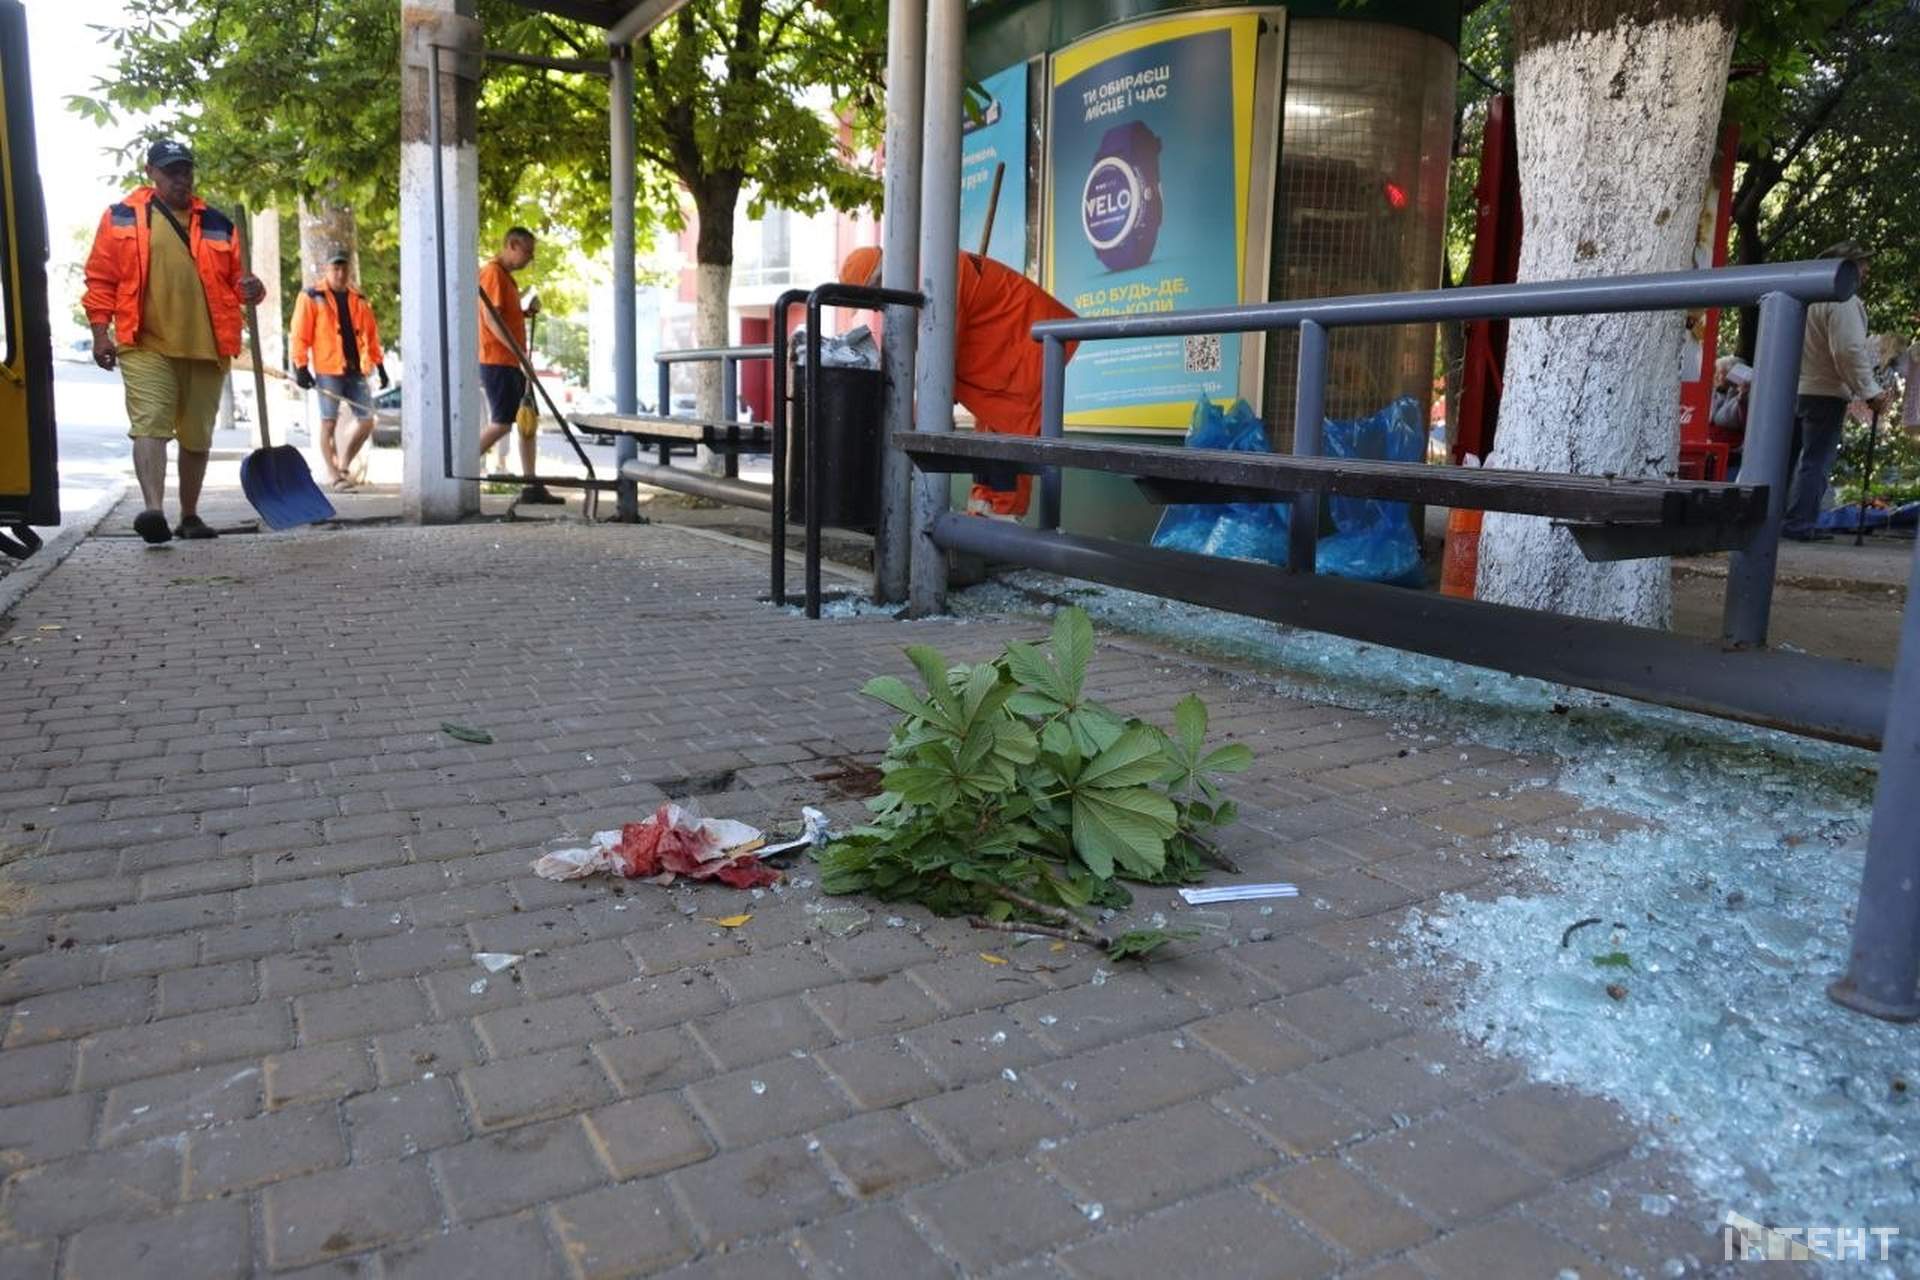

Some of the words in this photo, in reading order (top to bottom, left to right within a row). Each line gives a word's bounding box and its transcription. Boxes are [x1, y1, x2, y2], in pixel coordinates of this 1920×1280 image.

[1083, 88, 1098, 106] ТИ
[1099, 65, 1170, 99] ОБИРАЄШ
[1084, 96, 1125, 121] МІСЦЕ
[1136, 84, 1167, 103] ЧАС
[1086, 190, 1130, 218] VELO
[1075, 290, 1106, 309] VELO
